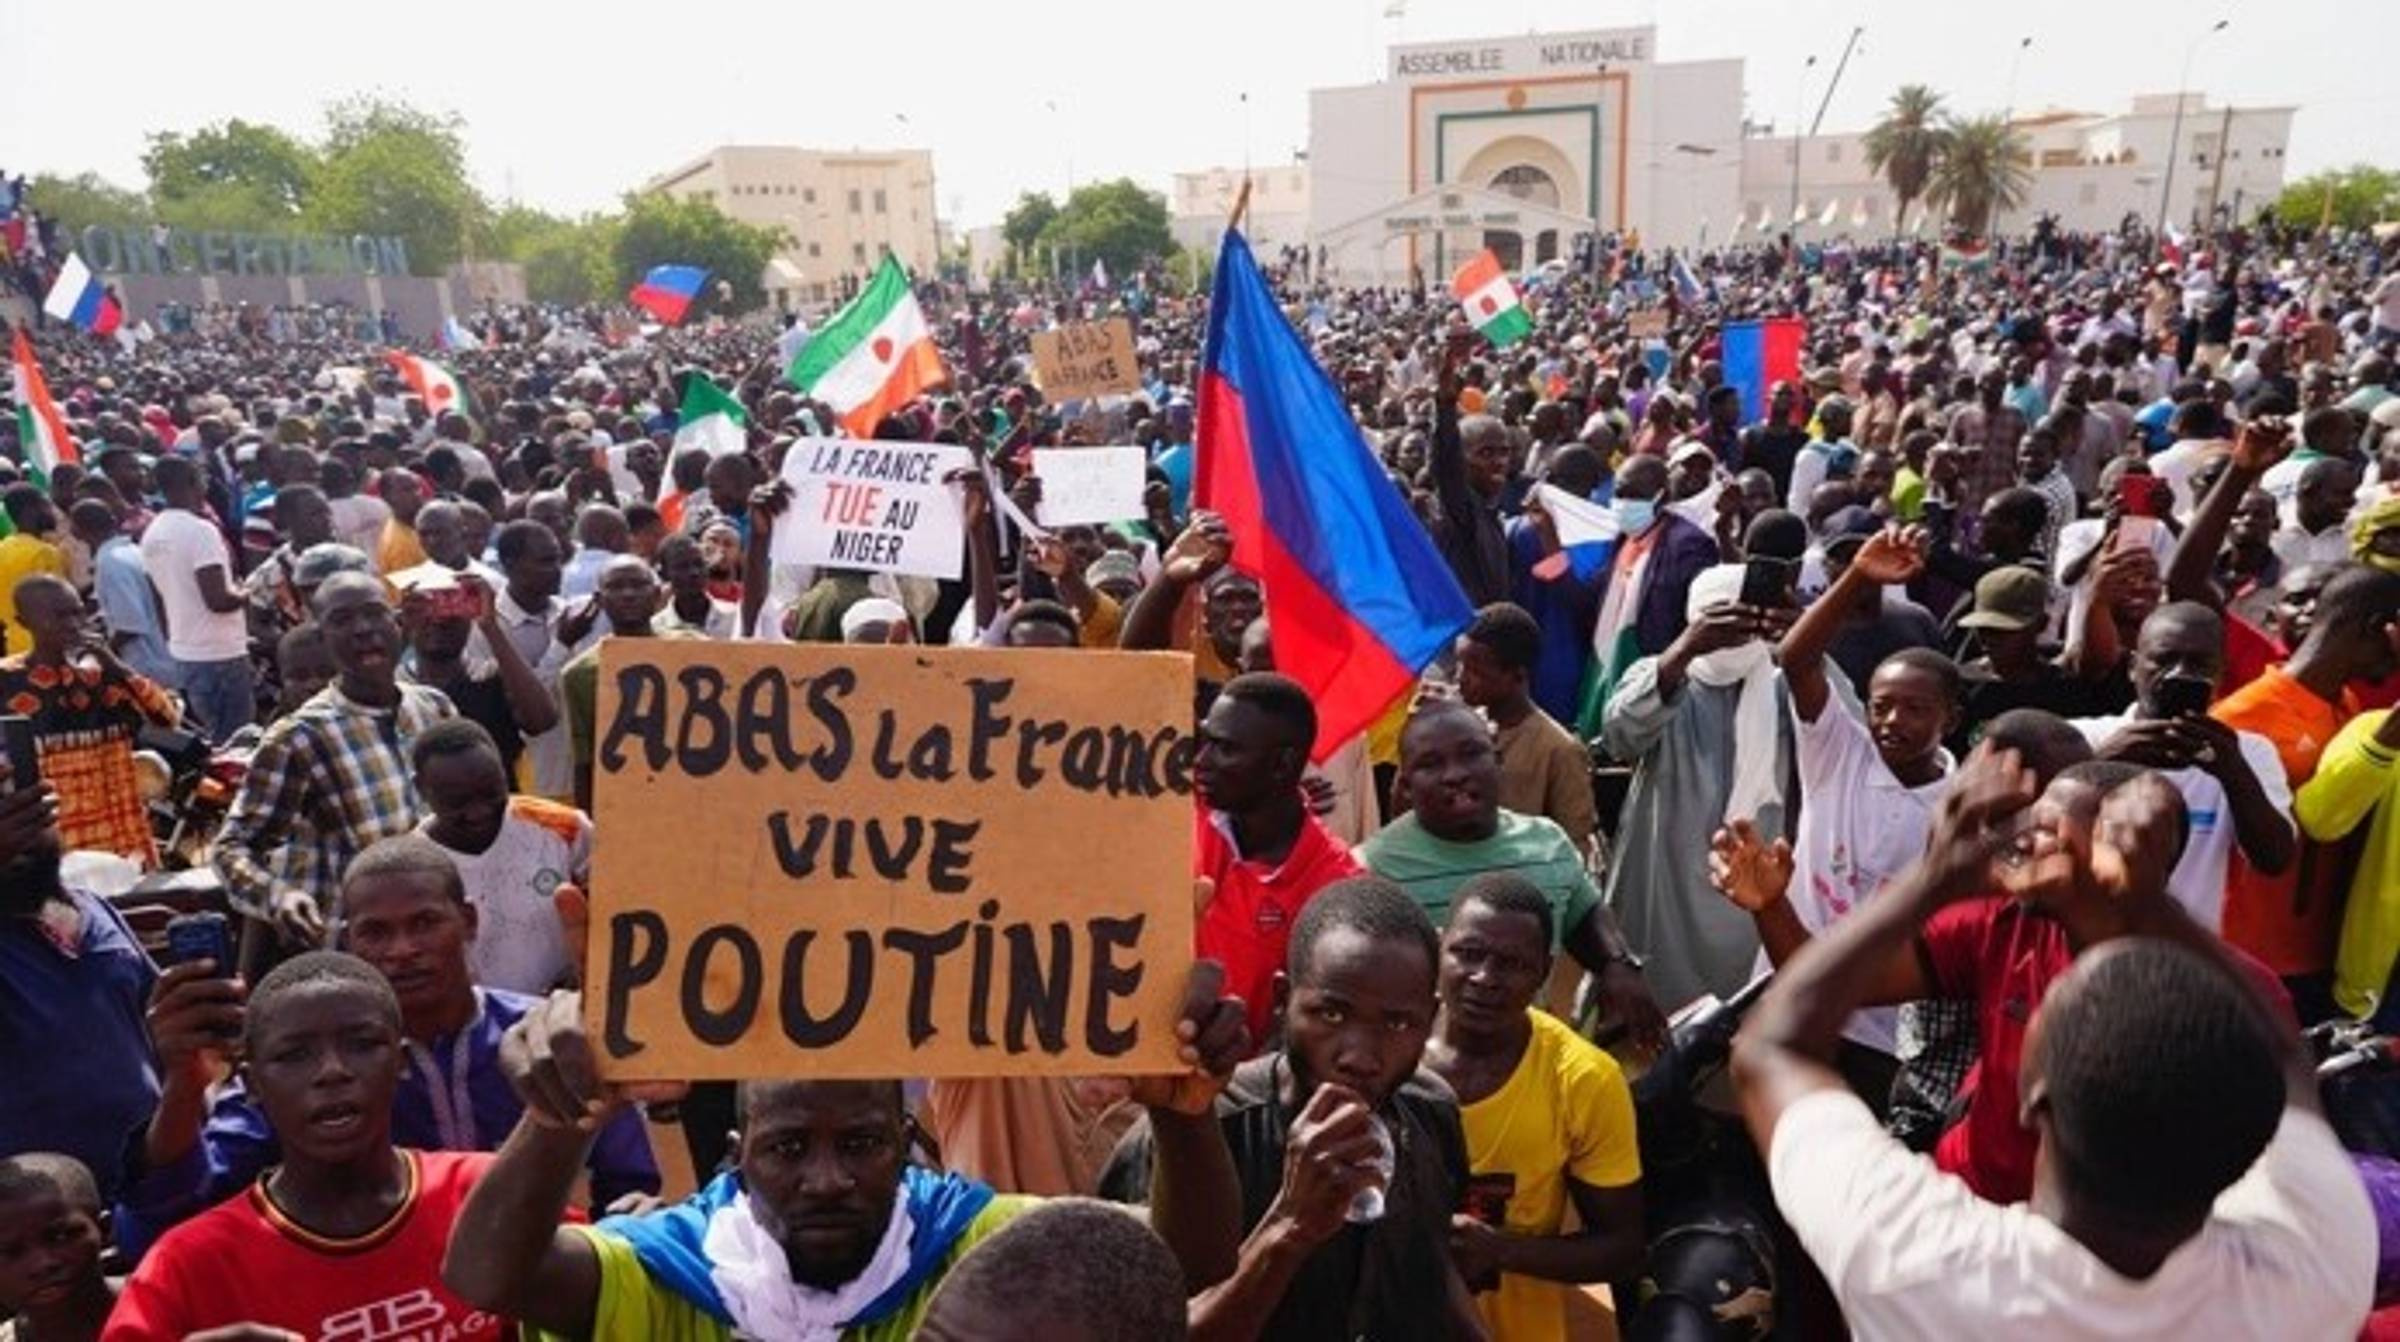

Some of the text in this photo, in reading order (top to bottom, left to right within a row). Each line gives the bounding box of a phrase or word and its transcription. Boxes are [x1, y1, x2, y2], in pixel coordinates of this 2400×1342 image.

[1398, 37, 1645, 75] ASSEMBLEE NATIONALE
[1058, 322, 1112, 361] ABAS
[809, 446, 938, 484] LA FRANCE
[823, 481, 919, 530] TUE AU
[830, 530, 904, 565] NIGER
[600, 663, 856, 782] ABAS
[964, 677, 1194, 798] France
[767, 811, 982, 893] VIVE
